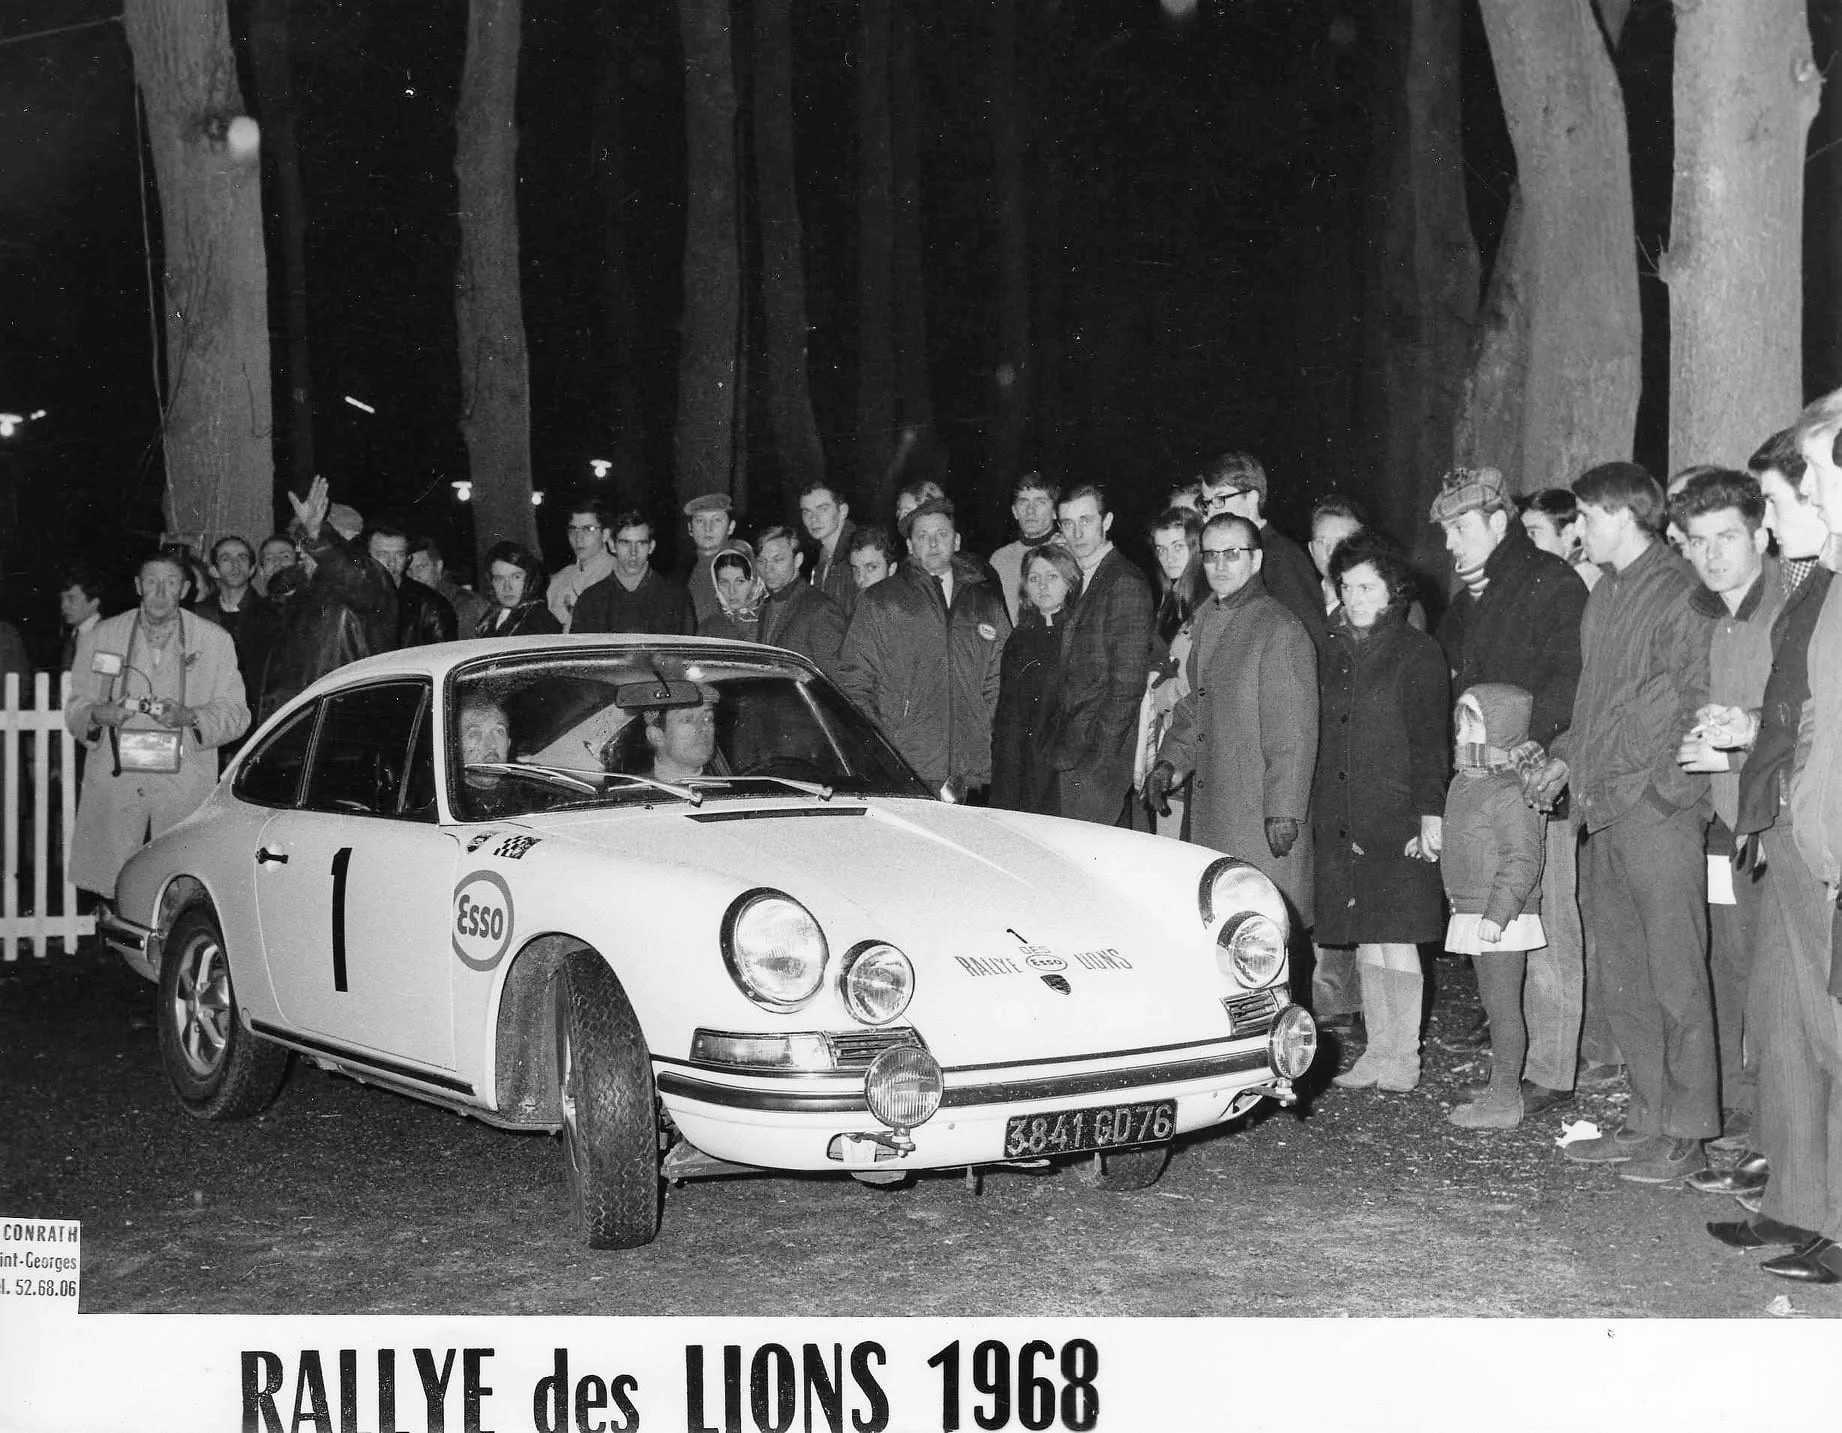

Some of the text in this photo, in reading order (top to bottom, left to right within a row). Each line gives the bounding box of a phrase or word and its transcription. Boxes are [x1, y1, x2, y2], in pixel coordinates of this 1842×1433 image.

[331, 847, 353, 992] 1
[953, 955, 1024, 977] RALLYE
[1073, 948, 1133, 970] LIONS
[1007, 1113, 1085, 1155] 3841
